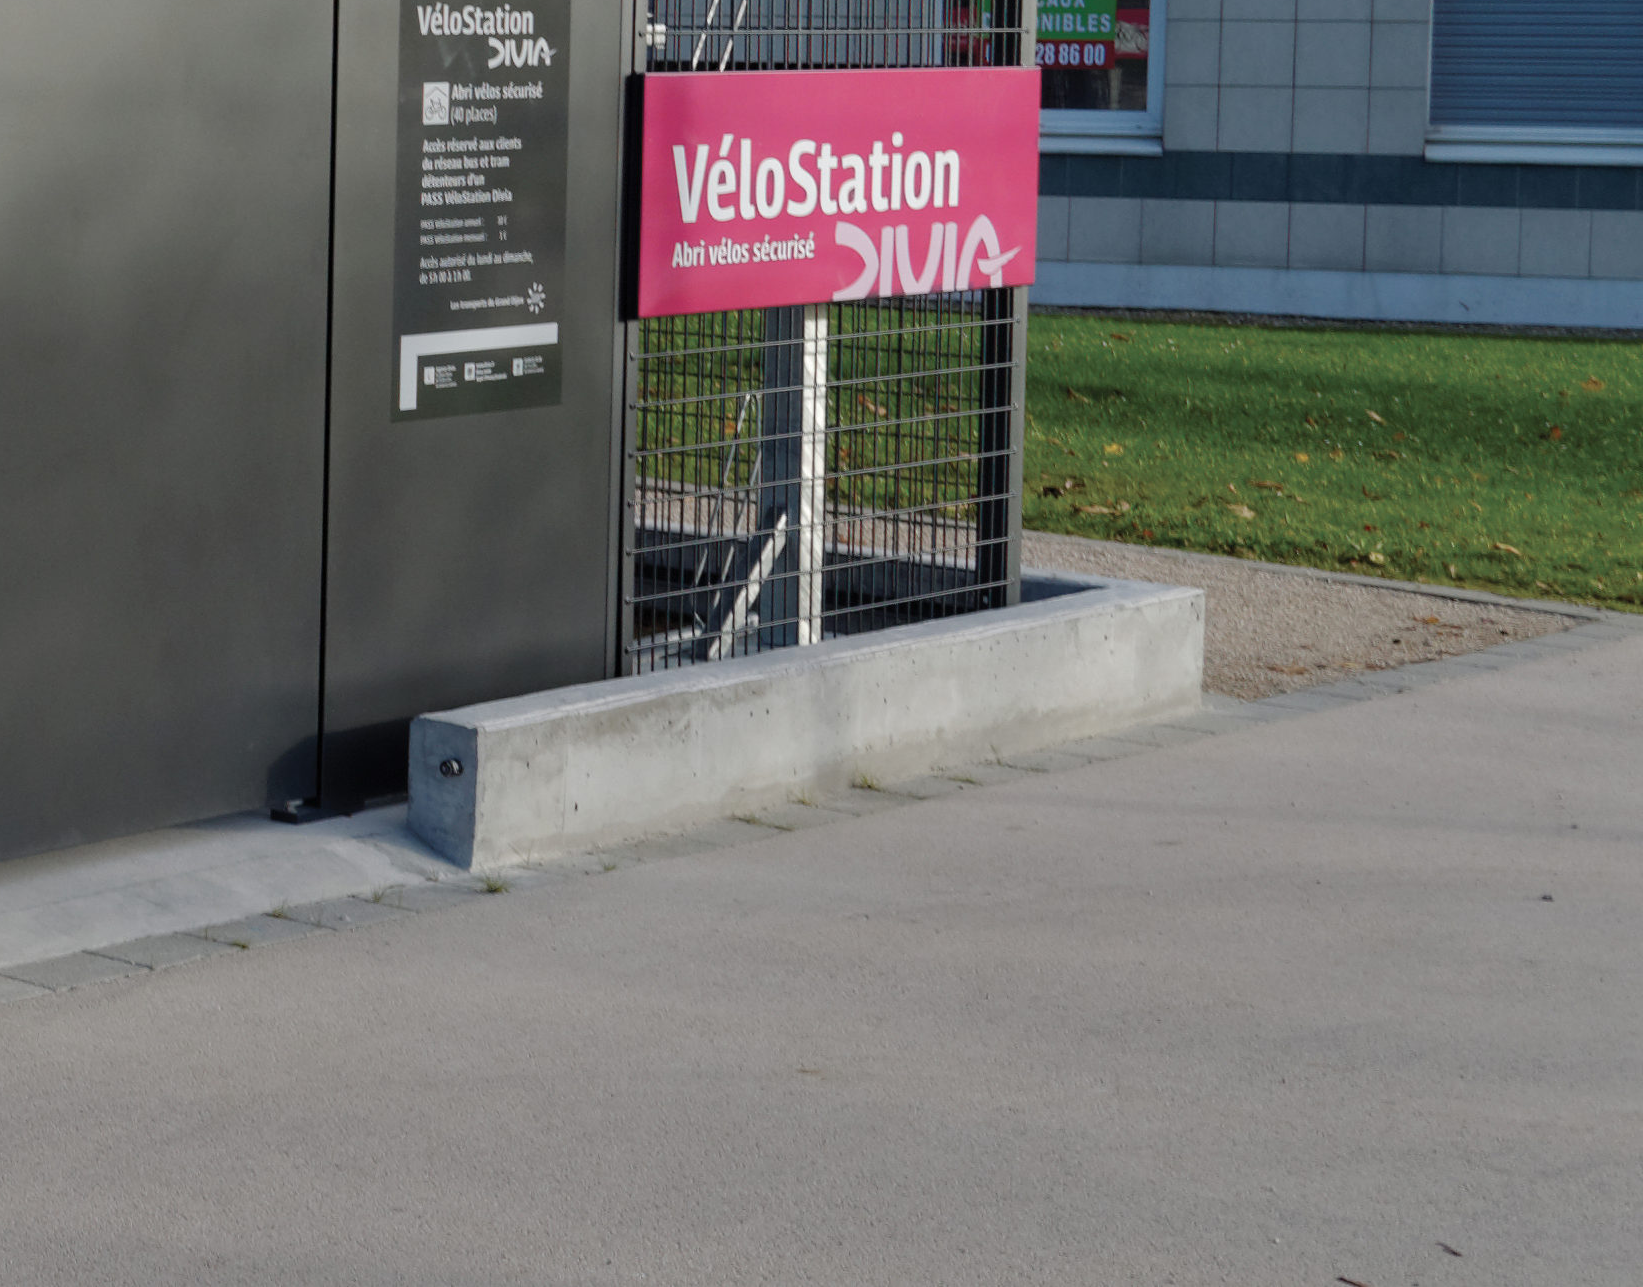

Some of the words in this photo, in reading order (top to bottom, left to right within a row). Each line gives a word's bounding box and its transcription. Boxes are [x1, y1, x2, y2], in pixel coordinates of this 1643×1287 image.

[417, 1, 534, 37] VéloStation
[1036, 12, 1111, 33] NIBLES
[1058, 42, 1081, 66] 86
[1083, 43, 1106, 66] 00
[451, 82, 473, 101] Abri
[475, 82, 501, 101] vélos
[502, 80, 544, 100] sécurisé
[465, 105, 498, 126] places)
[423, 138, 446, 153] Accès
[447, 137, 477, 152] réservé
[479, 140, 494, 151] aux
[496, 136, 522, 151] clients
[422, 156, 433, 171] du
[435, 156, 463, 170] réseau
[464, 155, 478, 169] bus
[479, 155, 489, 169] et
[490, 155, 511, 168] tram
[672, 131, 960, 224] VéloStation
[672, 240, 705, 269] Abri
[708, 236, 749, 267] vélos
[752, 231, 815, 261] sécurisé
